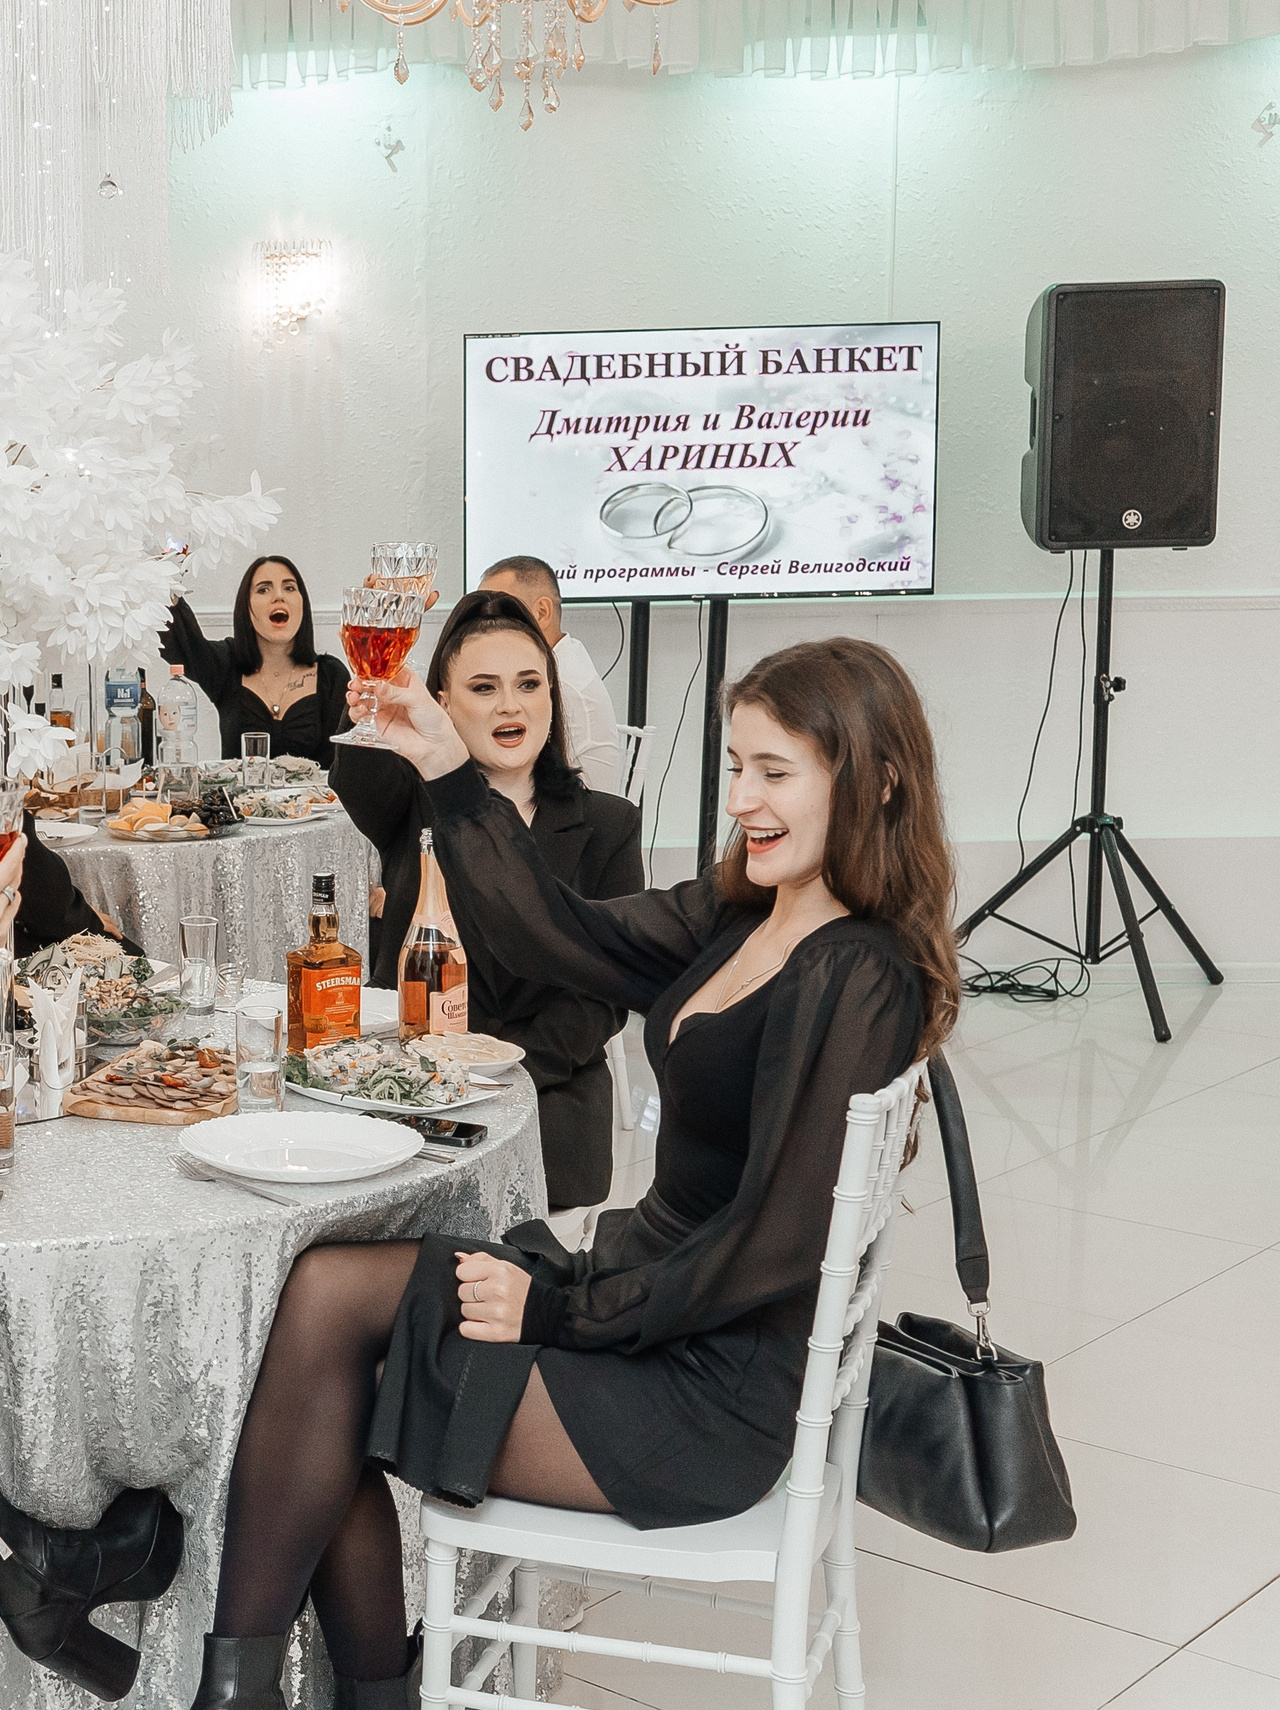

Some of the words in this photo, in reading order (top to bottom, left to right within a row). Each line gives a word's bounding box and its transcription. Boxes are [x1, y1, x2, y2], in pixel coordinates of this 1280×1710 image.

[485, 344, 746, 386] СВАДЕБНЫЙ
[758, 345, 923, 375] БАНКЕТ
[528, 409, 691, 442] Дмитрия
[702, 413, 721, 431] и
[732, 404, 872, 436] Валерии
[604, 441, 800, 472] ХАРИНЫХ
[583, 566, 696, 583] программы
[716, 559, 782, 579] Сергей
[788, 556, 911, 574] Велигодский
